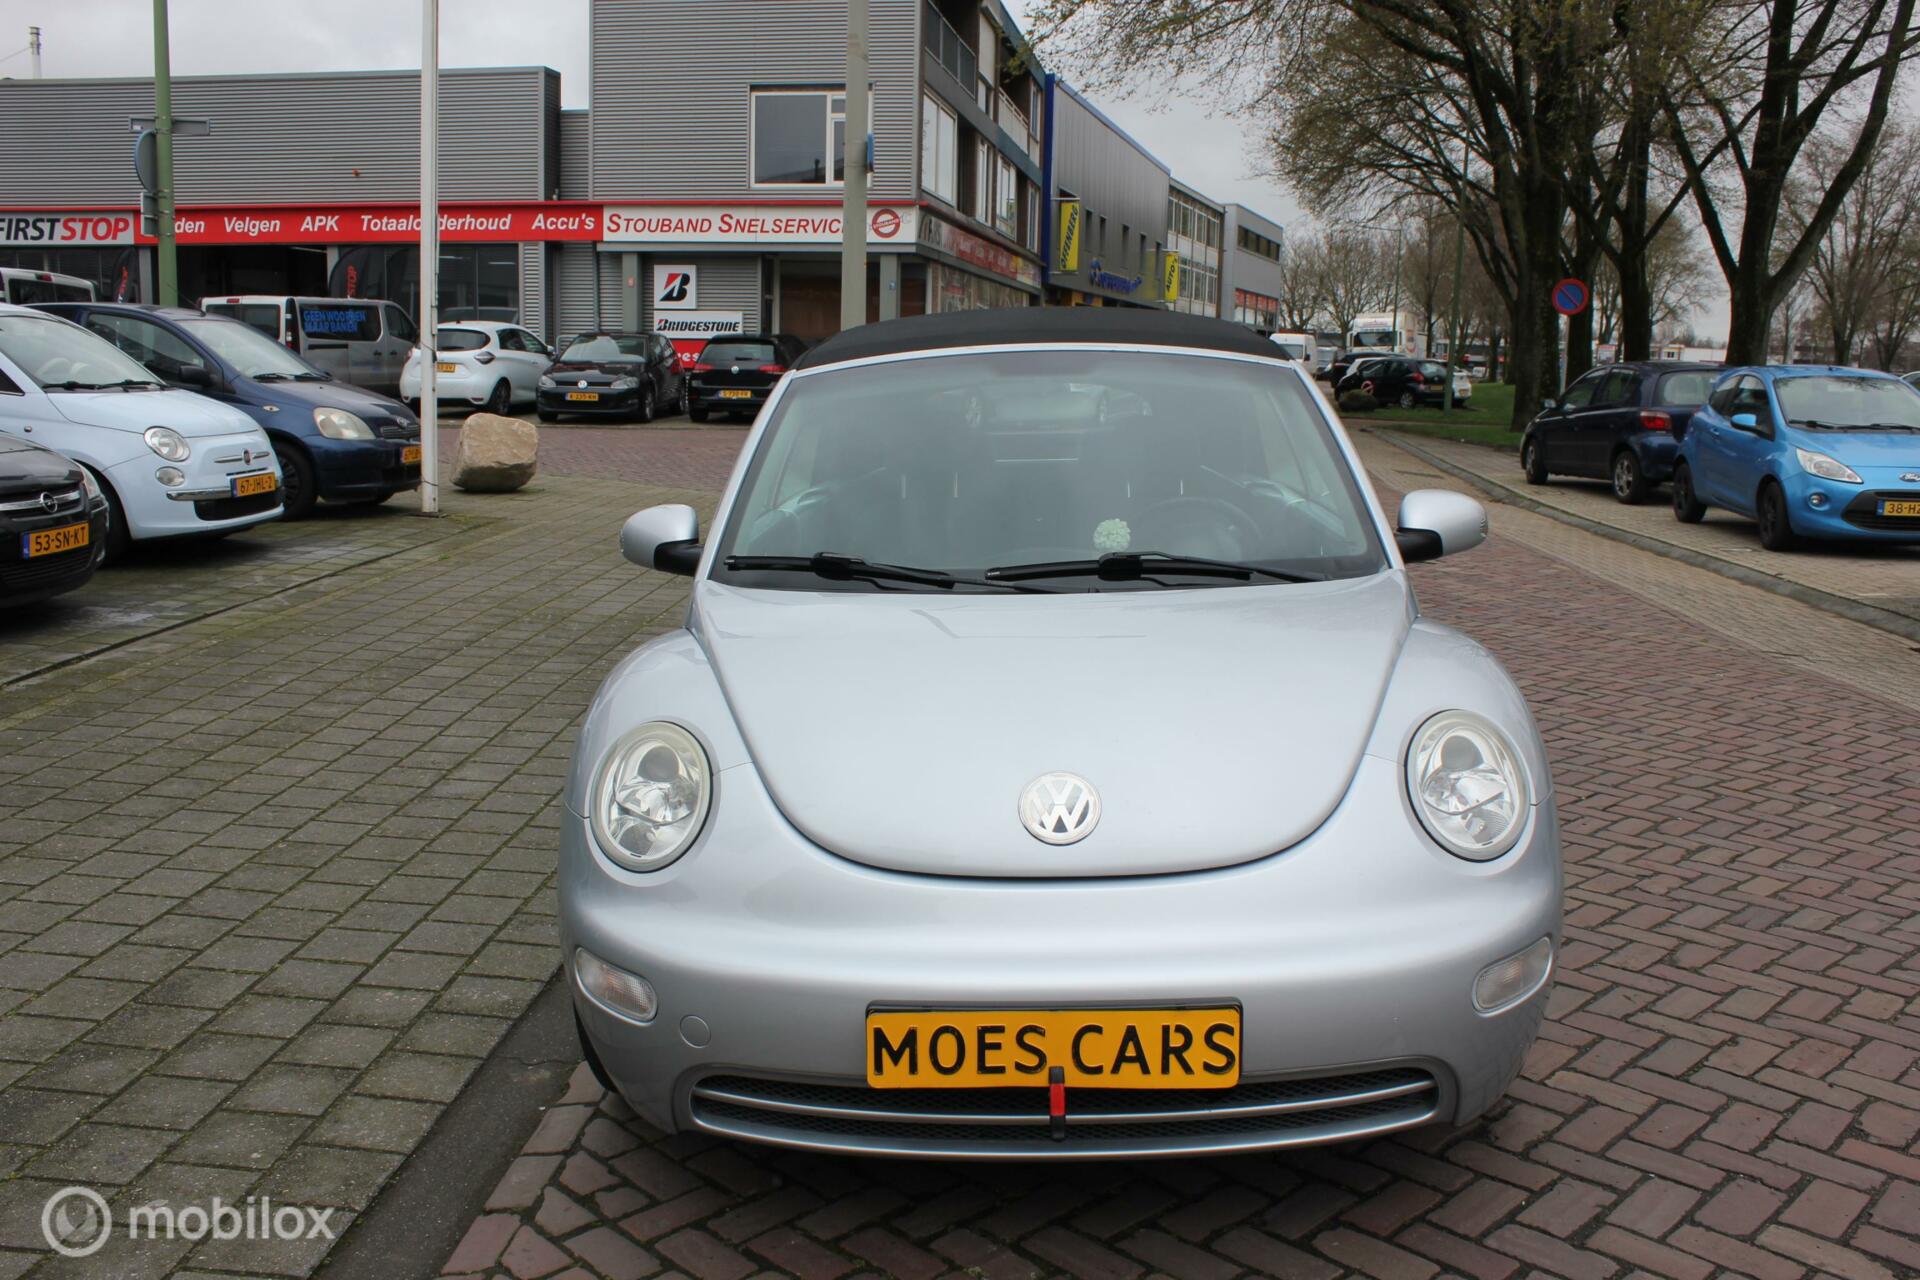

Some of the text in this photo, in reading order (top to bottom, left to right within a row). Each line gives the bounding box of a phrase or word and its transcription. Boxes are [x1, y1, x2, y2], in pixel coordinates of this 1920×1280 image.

[223, 216, 281, 234] Velgen
[301, 215, 340, 231] APK
[360, 214, 512, 231] Totaaloderhoud
[531, 213, 595, 230] Accu's
[607, 213, 843, 233] STOUBAND SNELSERVIC
[656, 319, 741, 332] BRIDGESTONE
[240, 476, 273, 494] 67-JHL-2
[35, 526, 86, 552] 53-SN-KT
[873, 1023, 1236, 1076] MOES CARS
